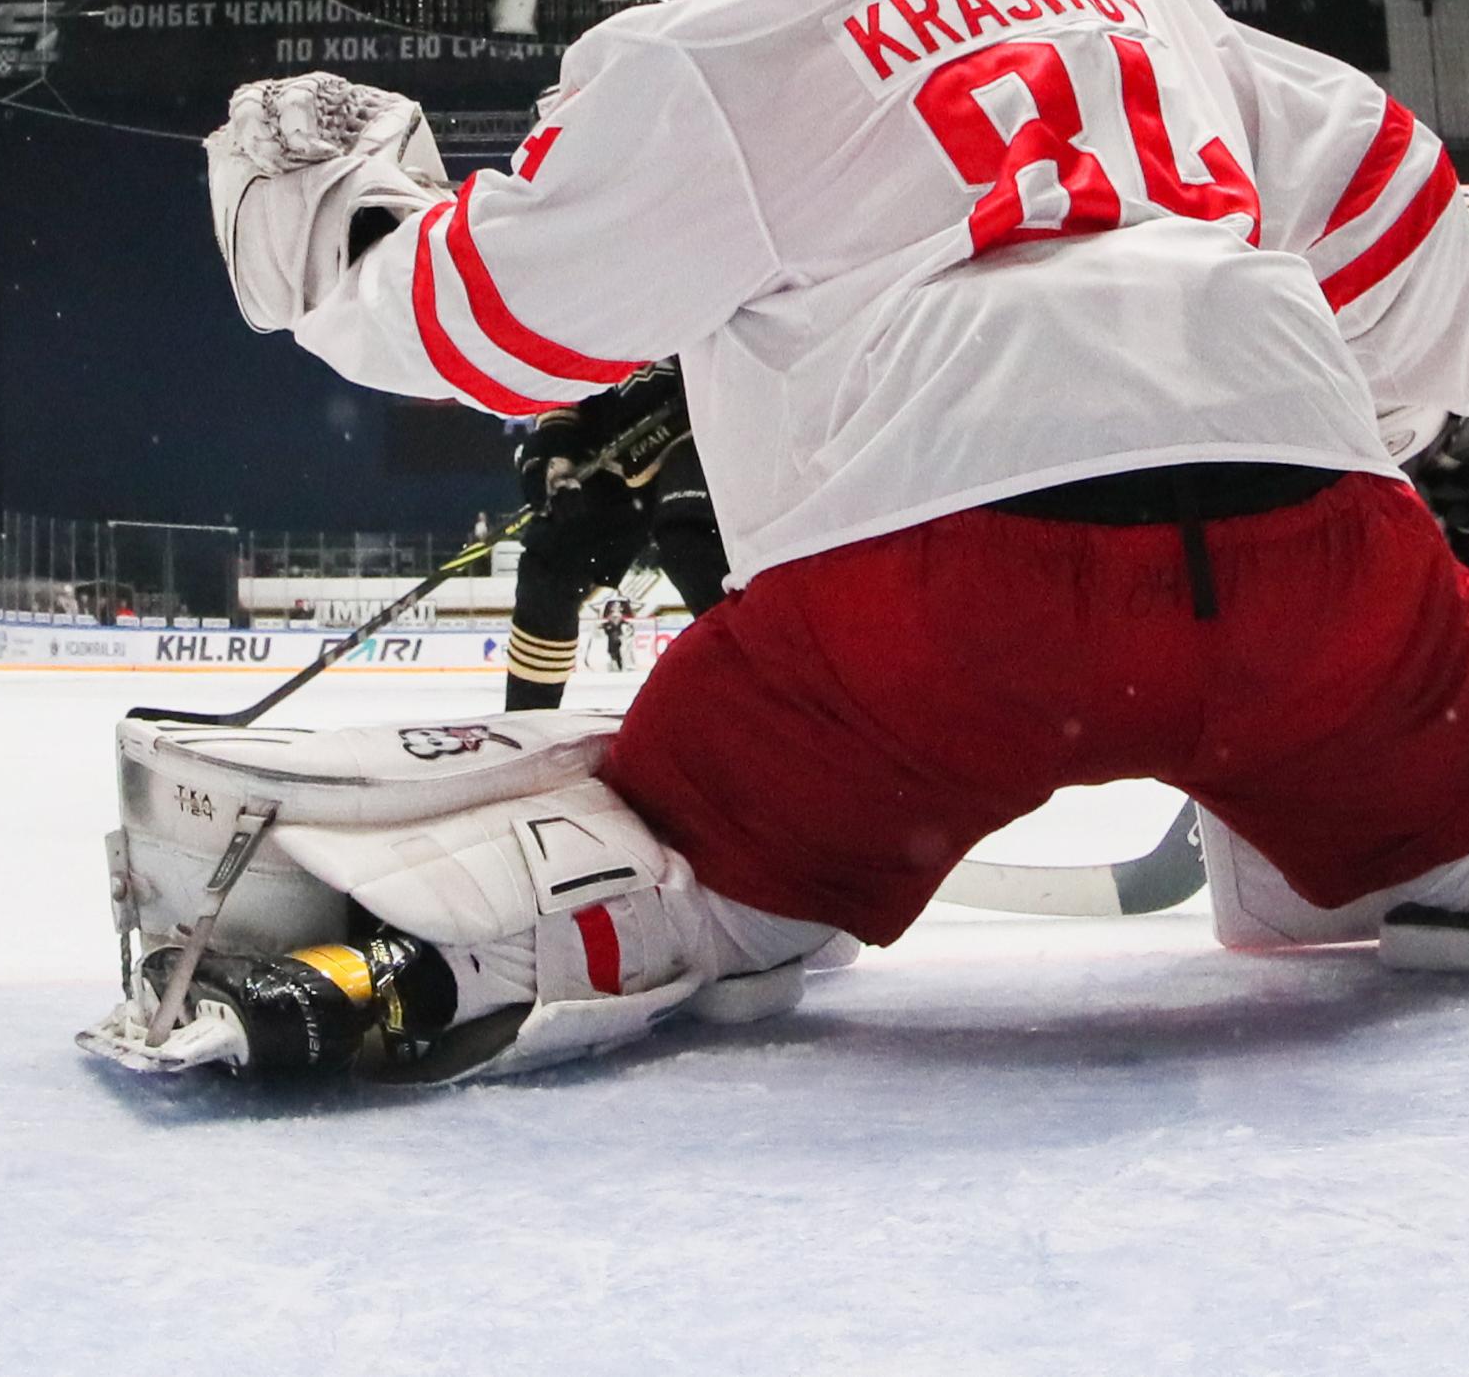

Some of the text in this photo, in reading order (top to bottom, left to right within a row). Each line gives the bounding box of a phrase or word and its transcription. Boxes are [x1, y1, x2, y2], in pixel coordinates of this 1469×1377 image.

[103, 2, 217, 29] ФОНБЕТ
[277, 38, 313, 62] ПО
[323, 34, 439, 61] ХОКЕЮ
[156, 635, 272, 662] KHL.RU
